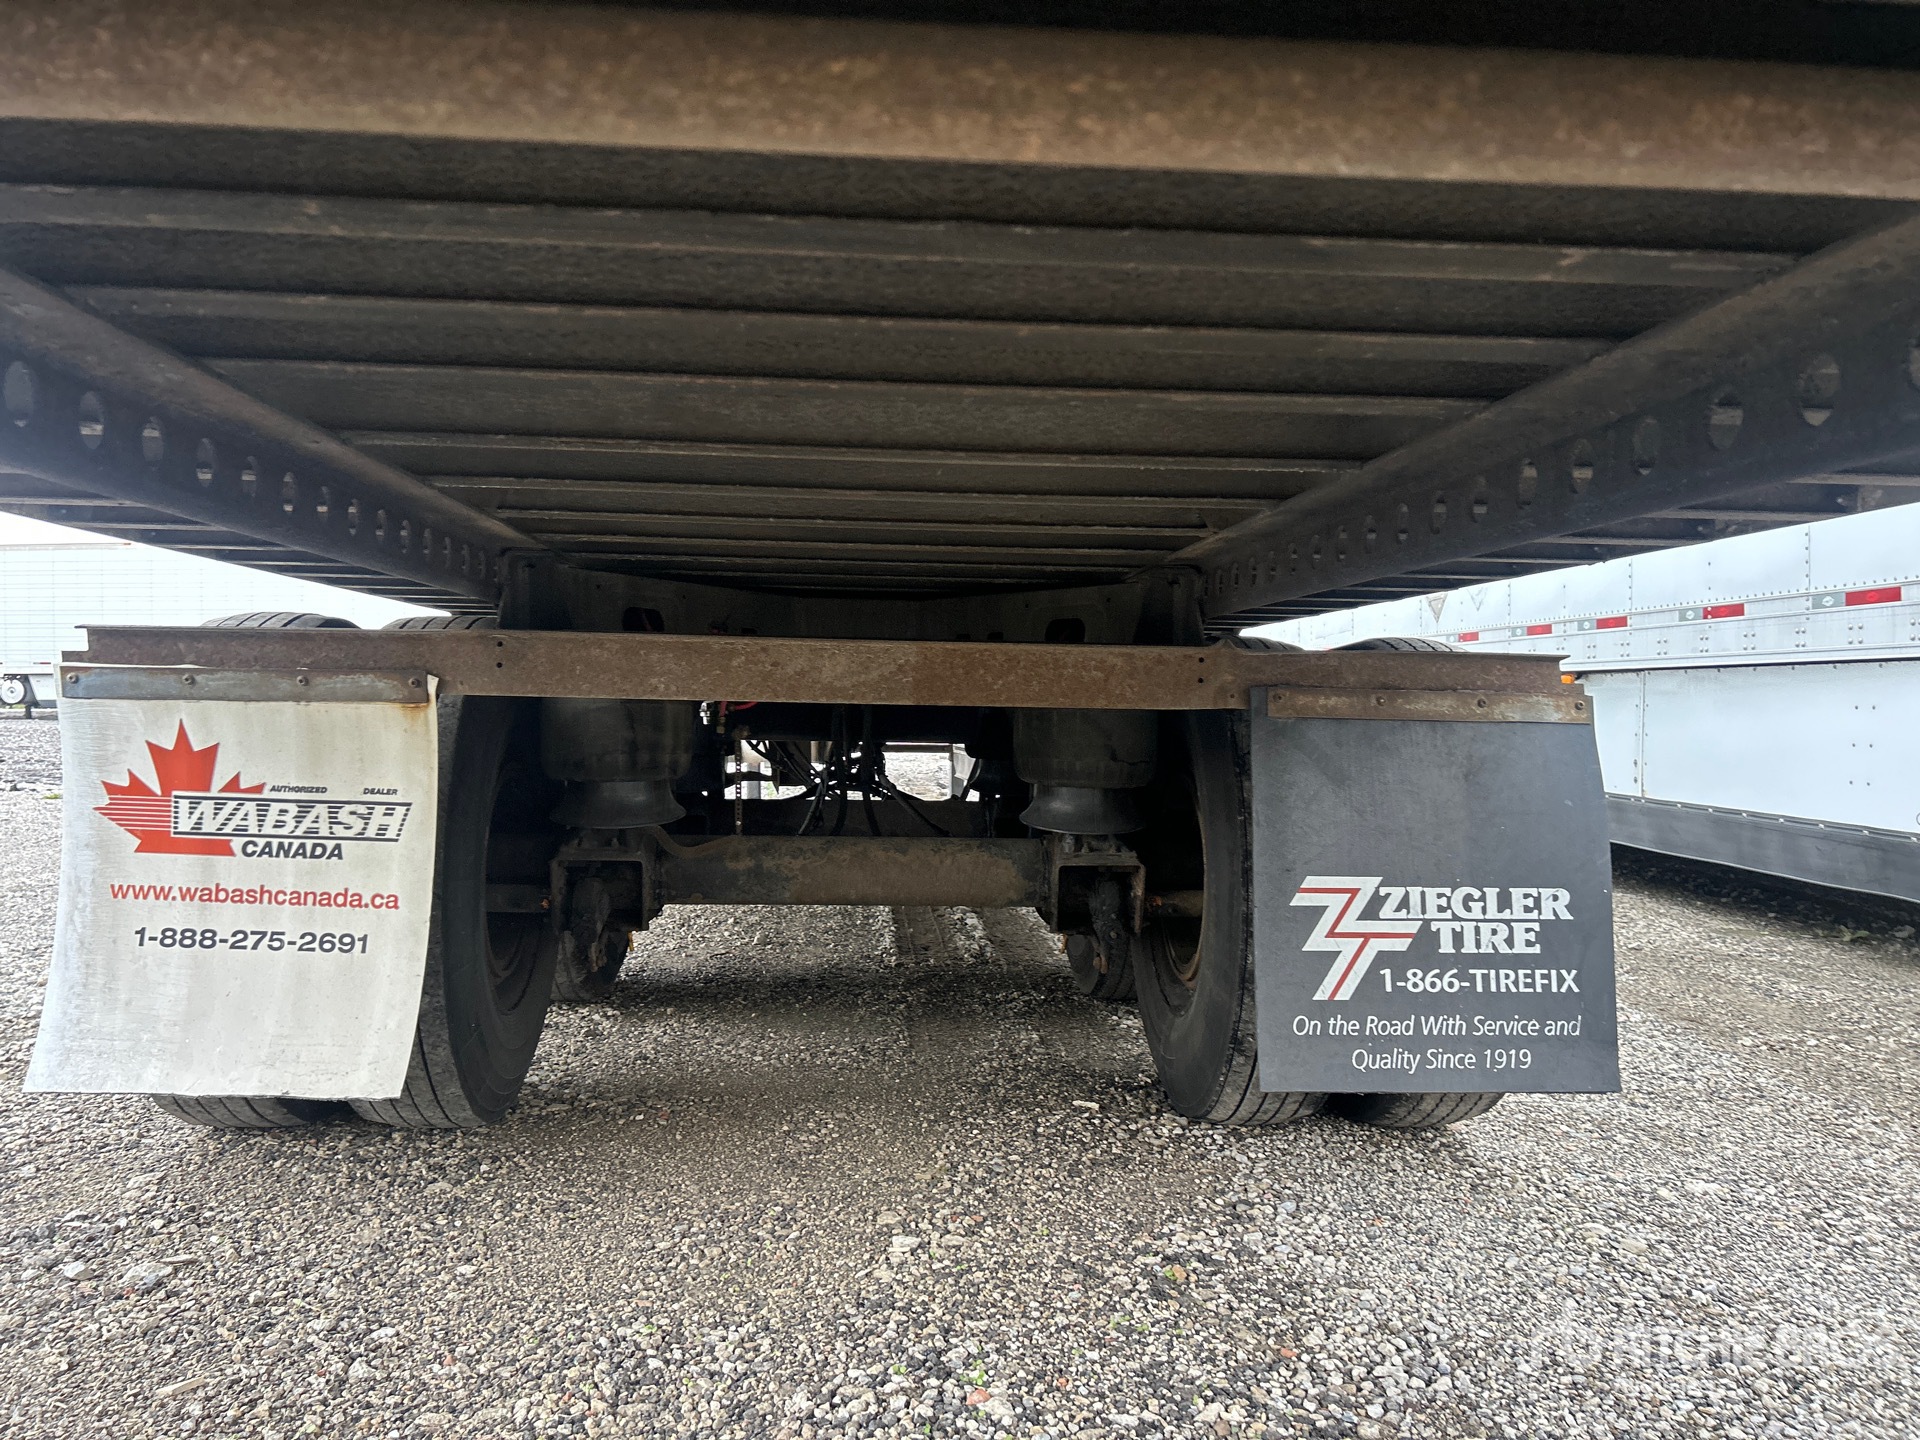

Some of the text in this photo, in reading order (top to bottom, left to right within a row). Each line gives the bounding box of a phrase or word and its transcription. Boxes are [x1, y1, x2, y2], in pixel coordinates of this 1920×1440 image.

[270, 785, 398, 796] AUTHORIZED DEALER
[176, 798, 410, 839] WABASH
[241, 840, 344, 860] CANADA
[110, 883, 400, 910] www.wabashcanada.ca
[1378, 886, 1574, 921] ZIEGLER
[134, 927, 369, 954] 1-888-275-2691
[1431, 921, 1541, 954] TIRE
[1379, 968, 1580, 993] 1-866-TIREFIX
[1292, 1015, 1582, 1036] On the Road With Service and
[1351, 1049, 1532, 1074] Quality Since 1919
